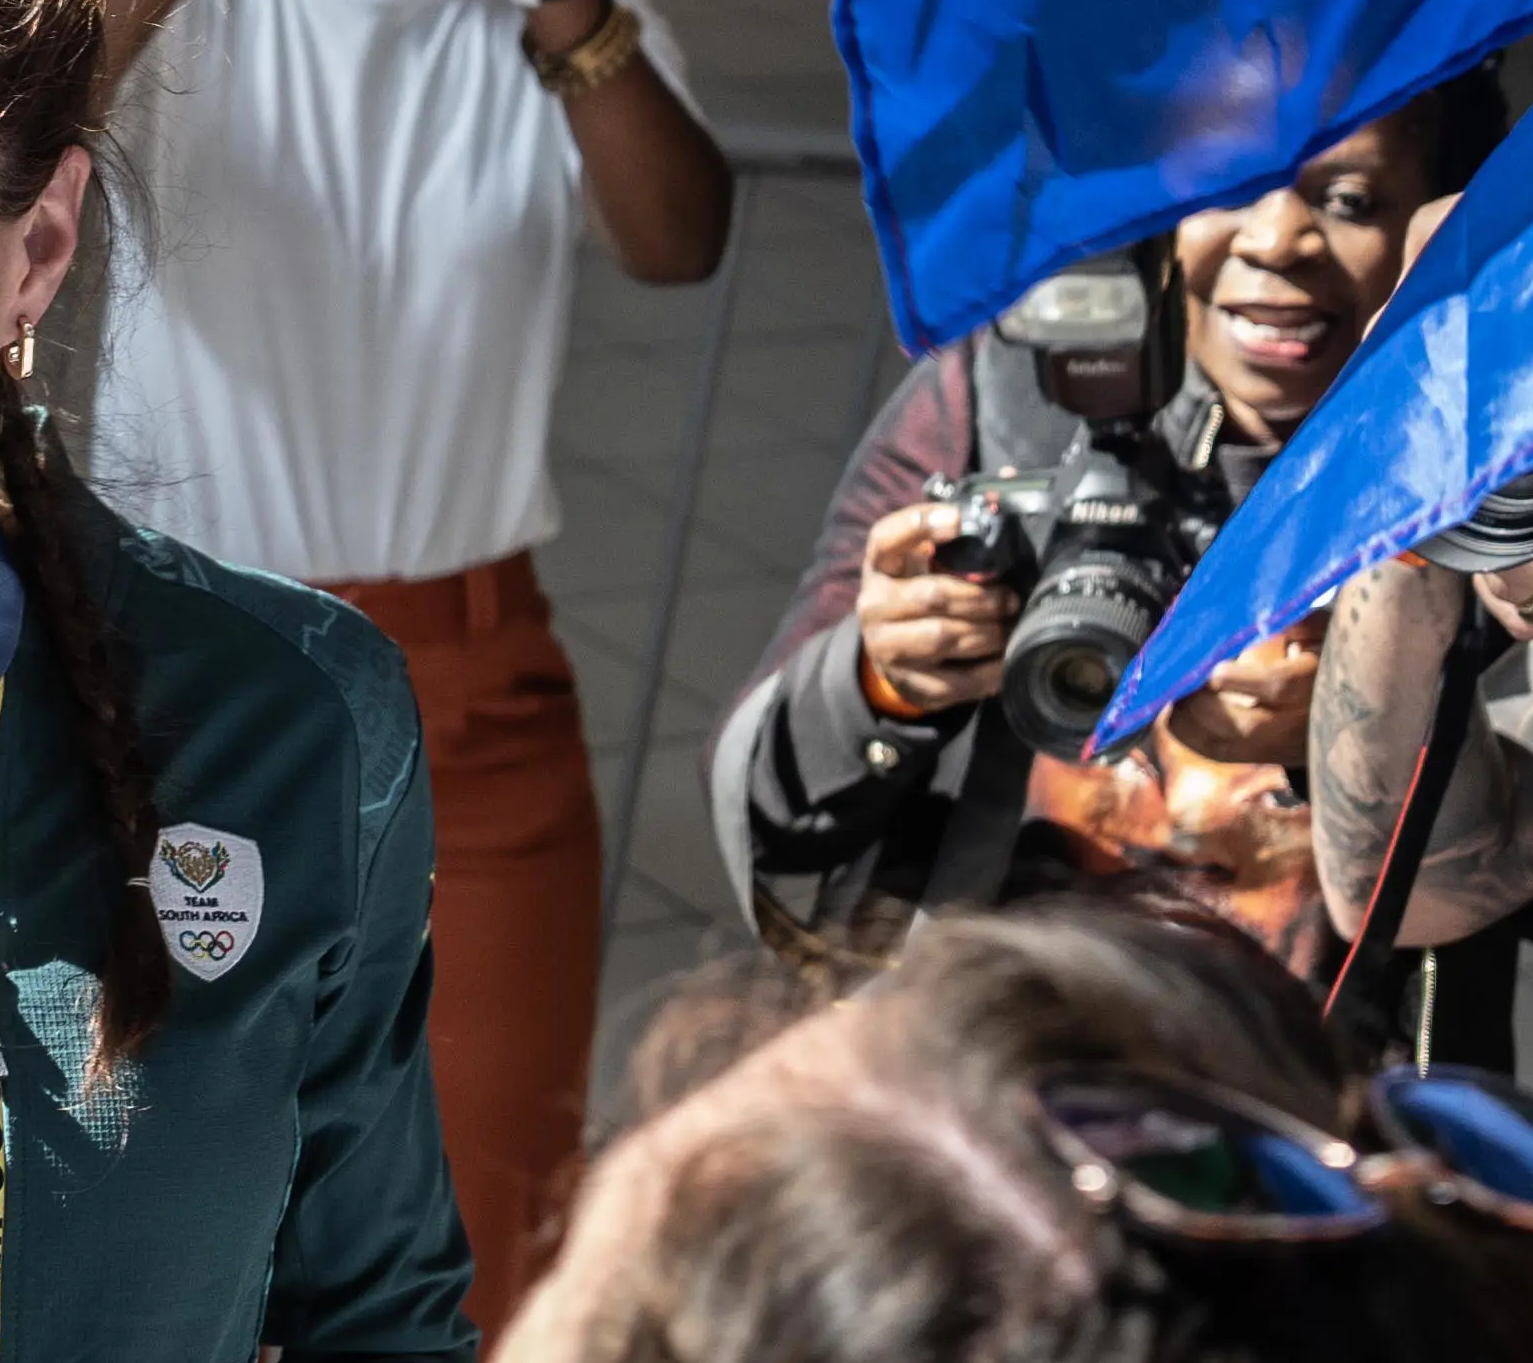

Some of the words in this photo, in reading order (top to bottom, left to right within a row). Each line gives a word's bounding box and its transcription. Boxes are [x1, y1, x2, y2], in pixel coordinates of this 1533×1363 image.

[1072, 500, 1138, 525] Nikon
[185, 896, 219, 907] TEAM
[159, 910, 200, 921] SOUTH
[203, 910, 249, 922] AFRICA
